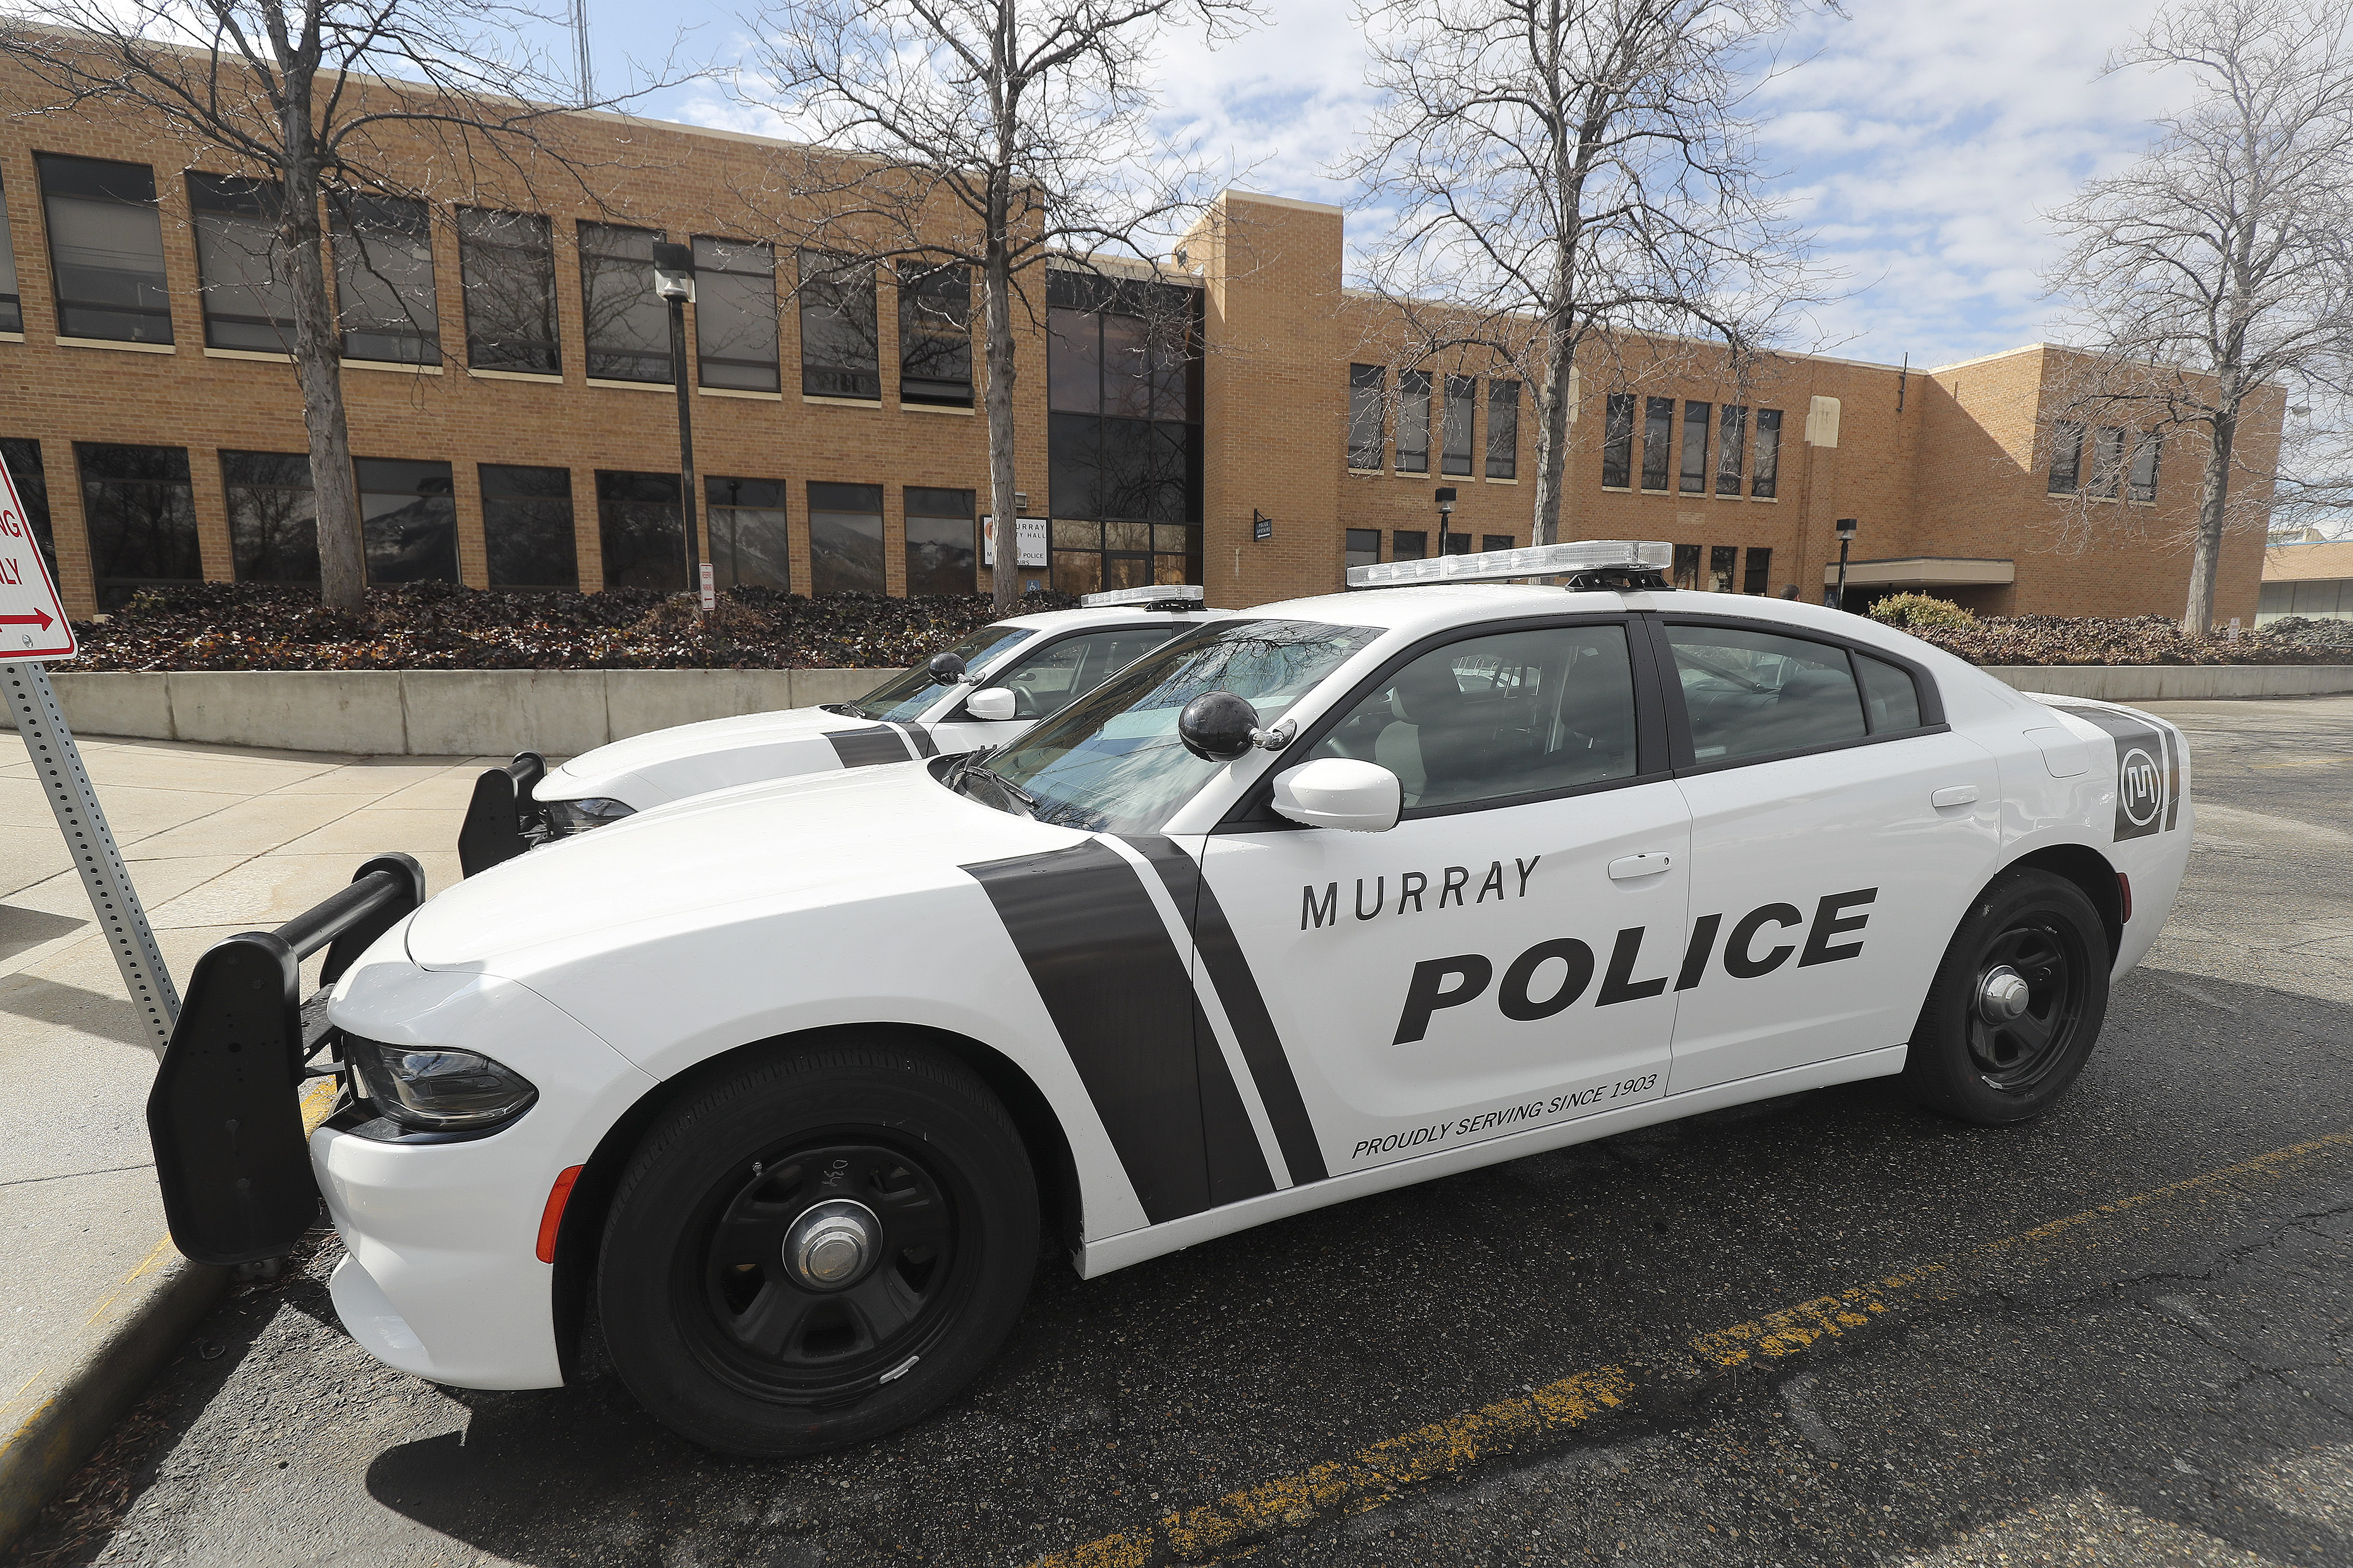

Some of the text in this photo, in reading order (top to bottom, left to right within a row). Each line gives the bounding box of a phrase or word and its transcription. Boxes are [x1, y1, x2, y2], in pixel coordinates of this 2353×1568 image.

[1300, 855, 1542, 931] MURRAY
[1391, 886, 1880, 1046] POLICE
[1351, 1073, 1659, 1160] PROUDLY SERVING SINCE 1903
